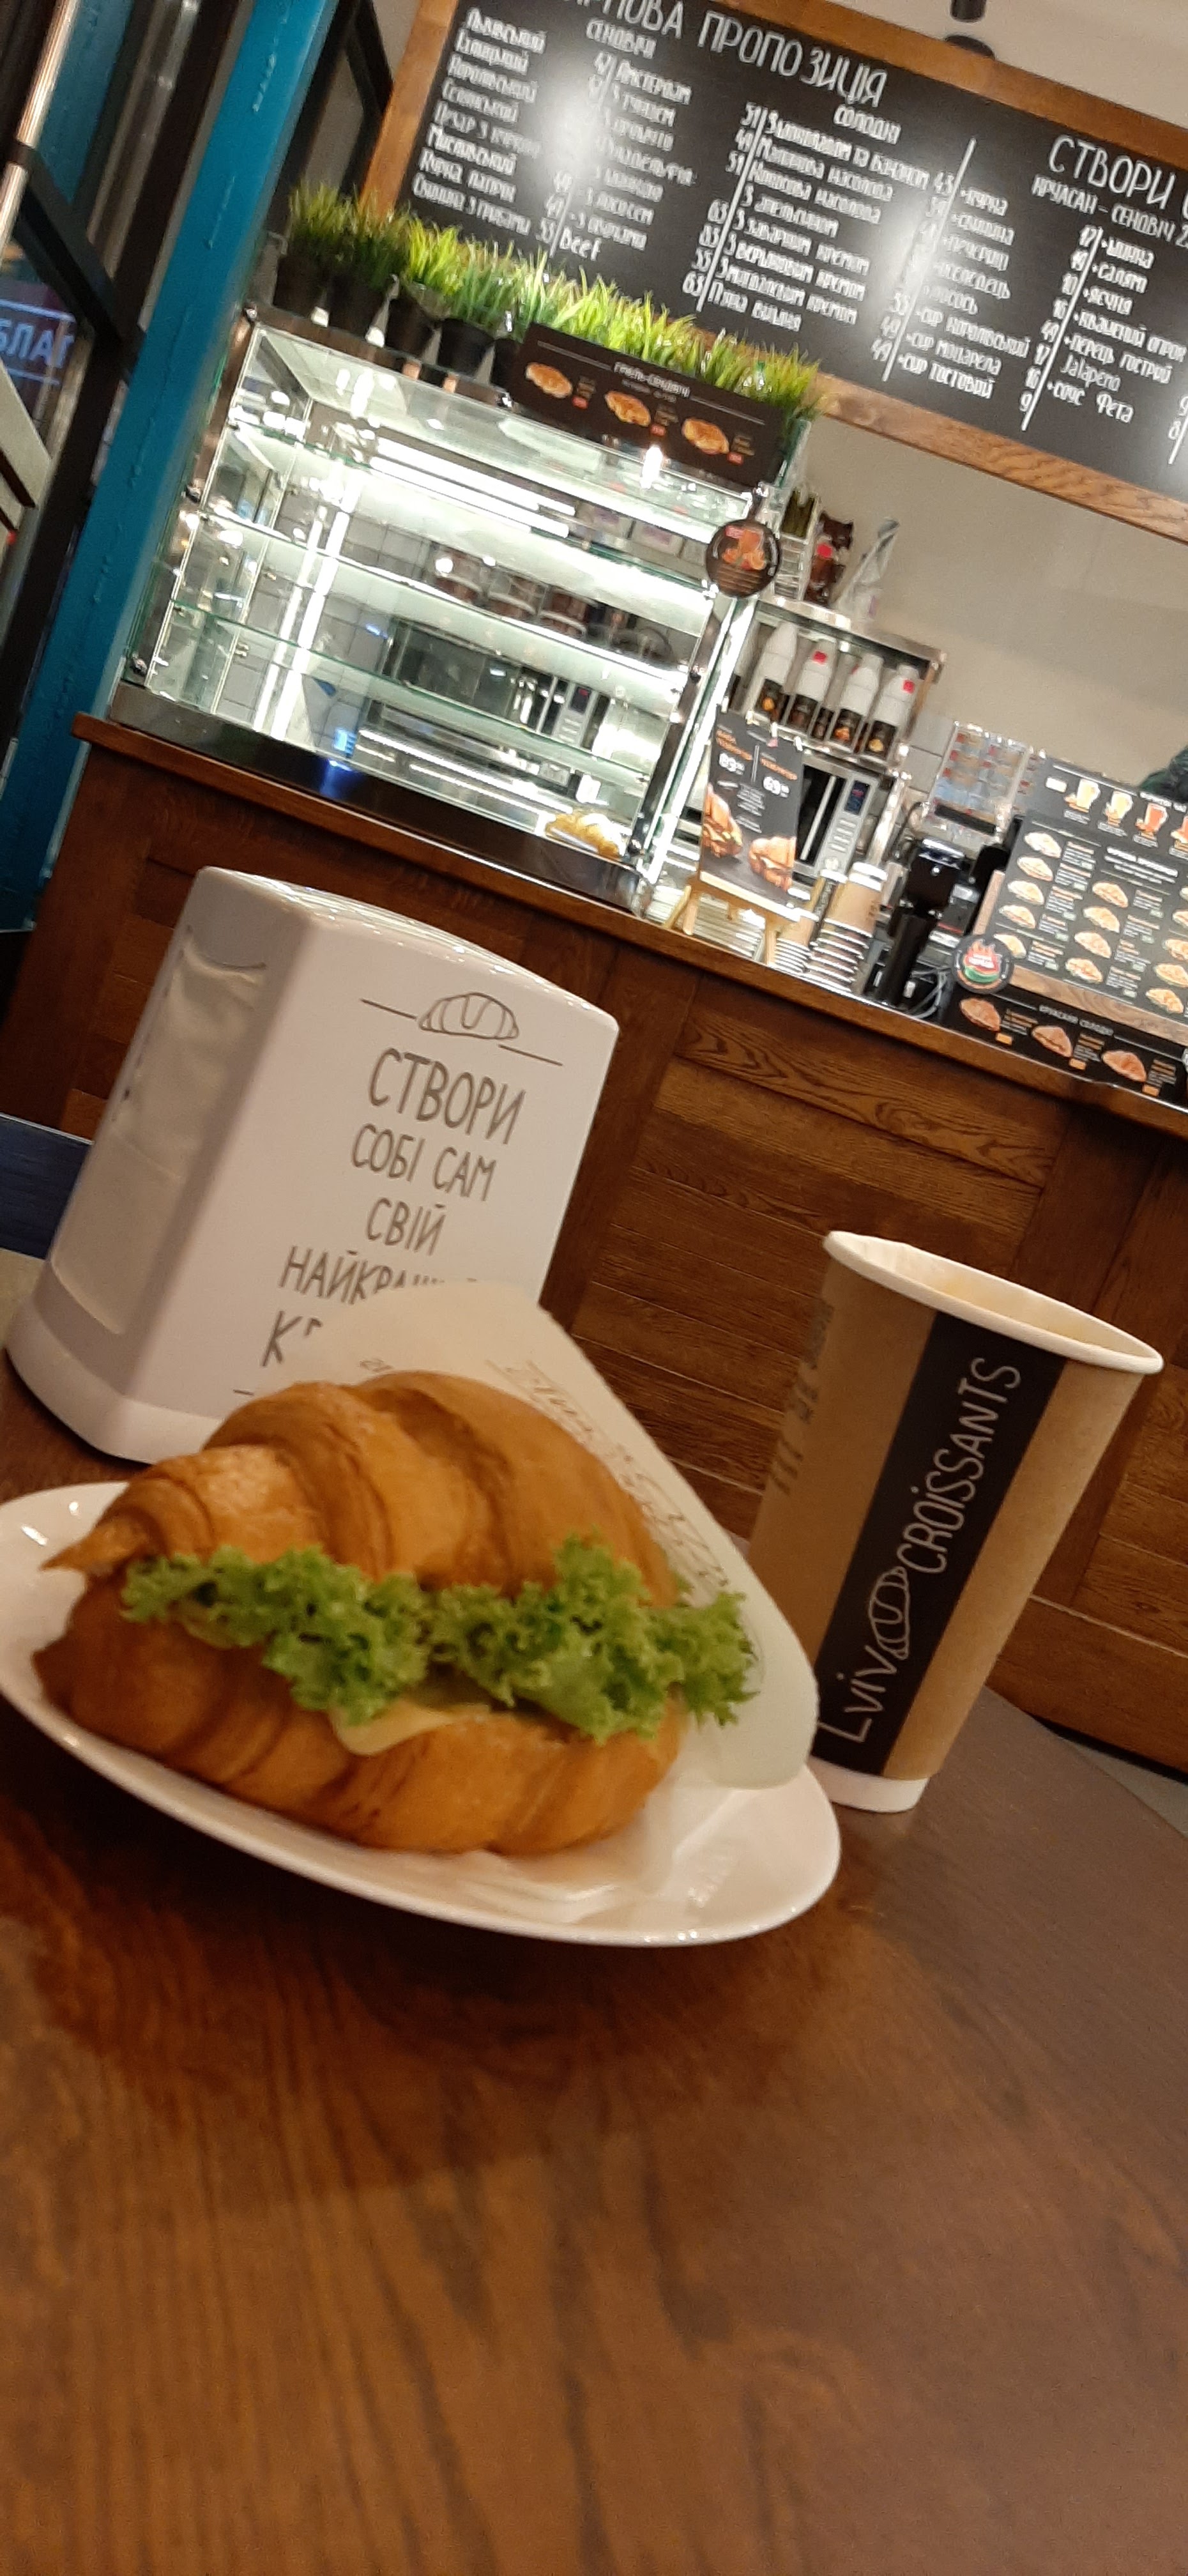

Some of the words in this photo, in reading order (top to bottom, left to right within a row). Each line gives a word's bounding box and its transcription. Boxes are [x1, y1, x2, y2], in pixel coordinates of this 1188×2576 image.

[1049, 134, 1177, 210] СТВОРИ
[368, 1048, 526, 1144] СТВОРИ
[352, 1123, 425, 1182] СОБІ
[432, 1147, 497, 1202] САМ
[367, 1197, 446, 1256] СВІЙ
